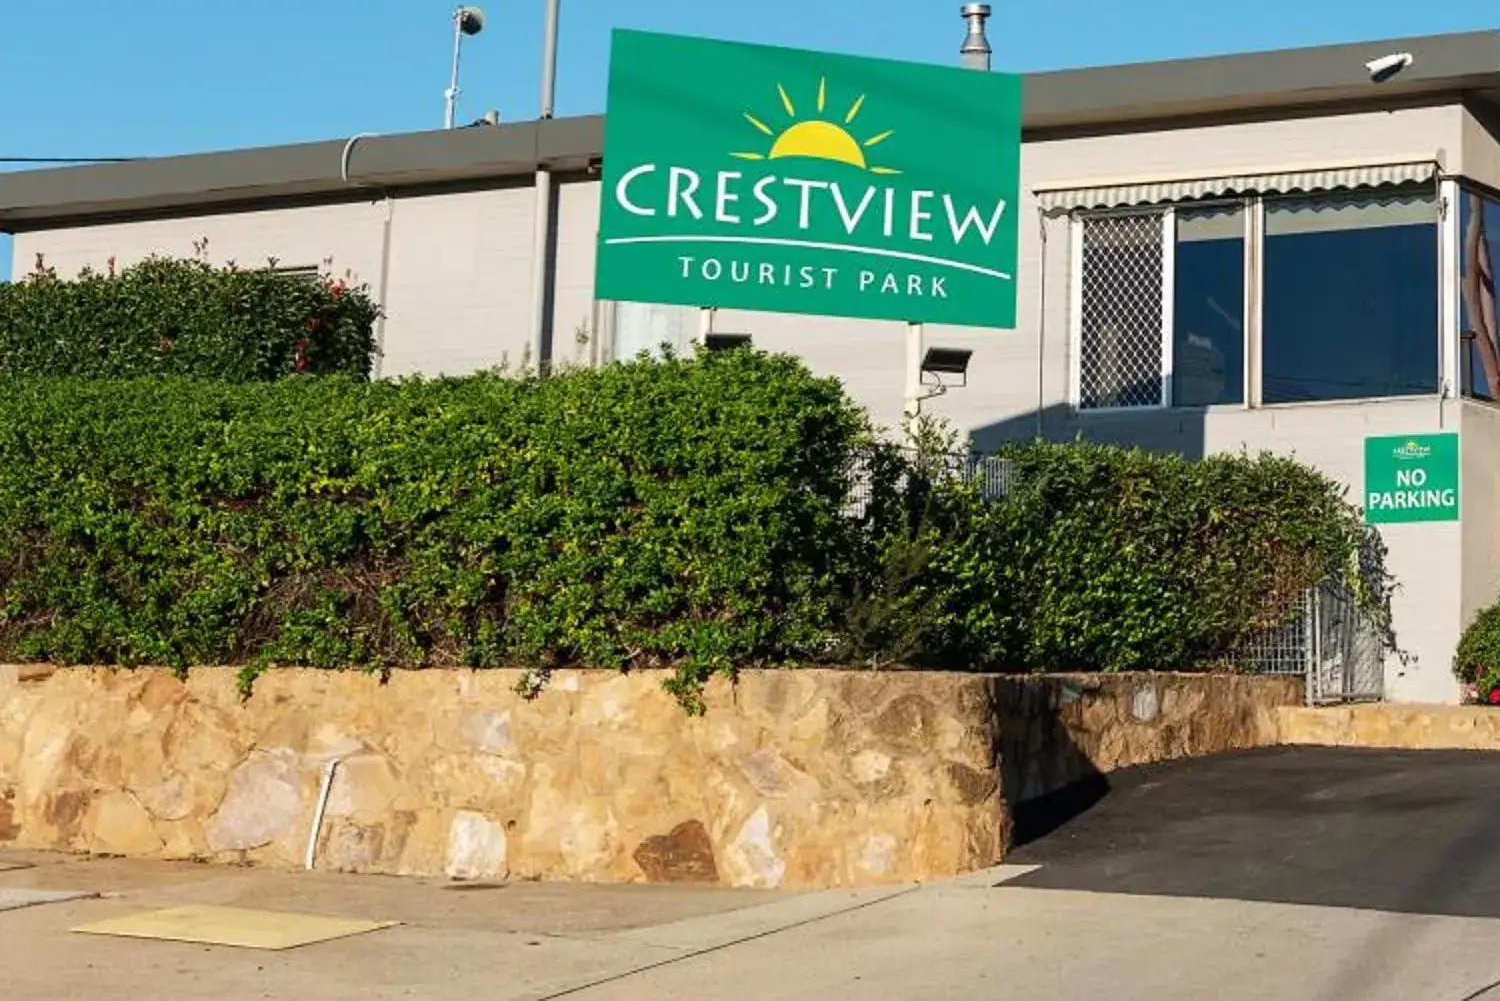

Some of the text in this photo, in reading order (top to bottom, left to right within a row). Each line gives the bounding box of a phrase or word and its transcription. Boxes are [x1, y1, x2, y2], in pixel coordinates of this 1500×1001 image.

[615, 164, 1007, 246] CRESTVIEW
[678, 256, 948, 298] TOURIST PARK
[1396, 468, 1427, 487] NO
[1368, 488, 1455, 510] PARKING
